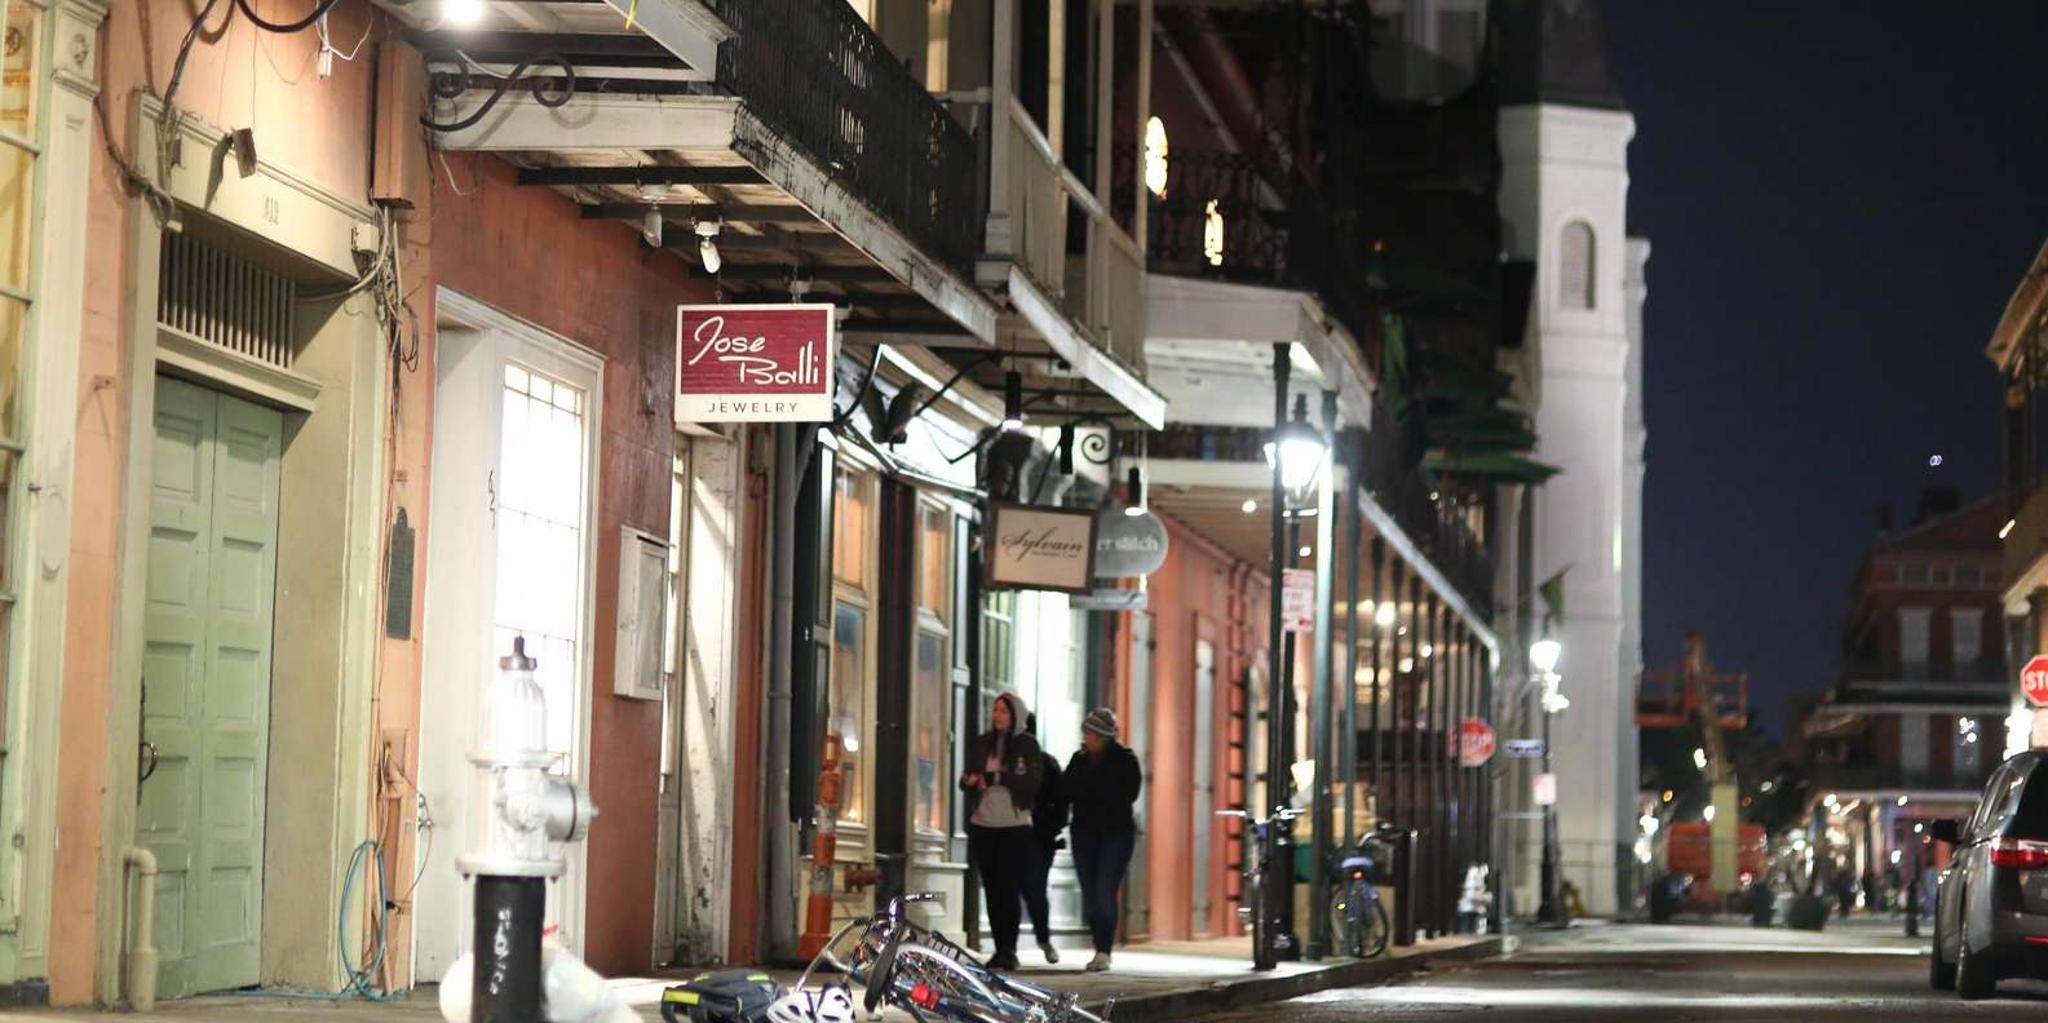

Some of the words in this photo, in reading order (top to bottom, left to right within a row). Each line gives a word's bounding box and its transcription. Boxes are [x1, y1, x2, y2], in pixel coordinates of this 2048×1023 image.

[688, 316, 766, 366] Jose
[719, 341, 819, 385] Balli
[708, 402, 798, 413] JEWELRY
[1002, 526, 1084, 561] Sylvain
[2024, 671, 2048, 690] ST
